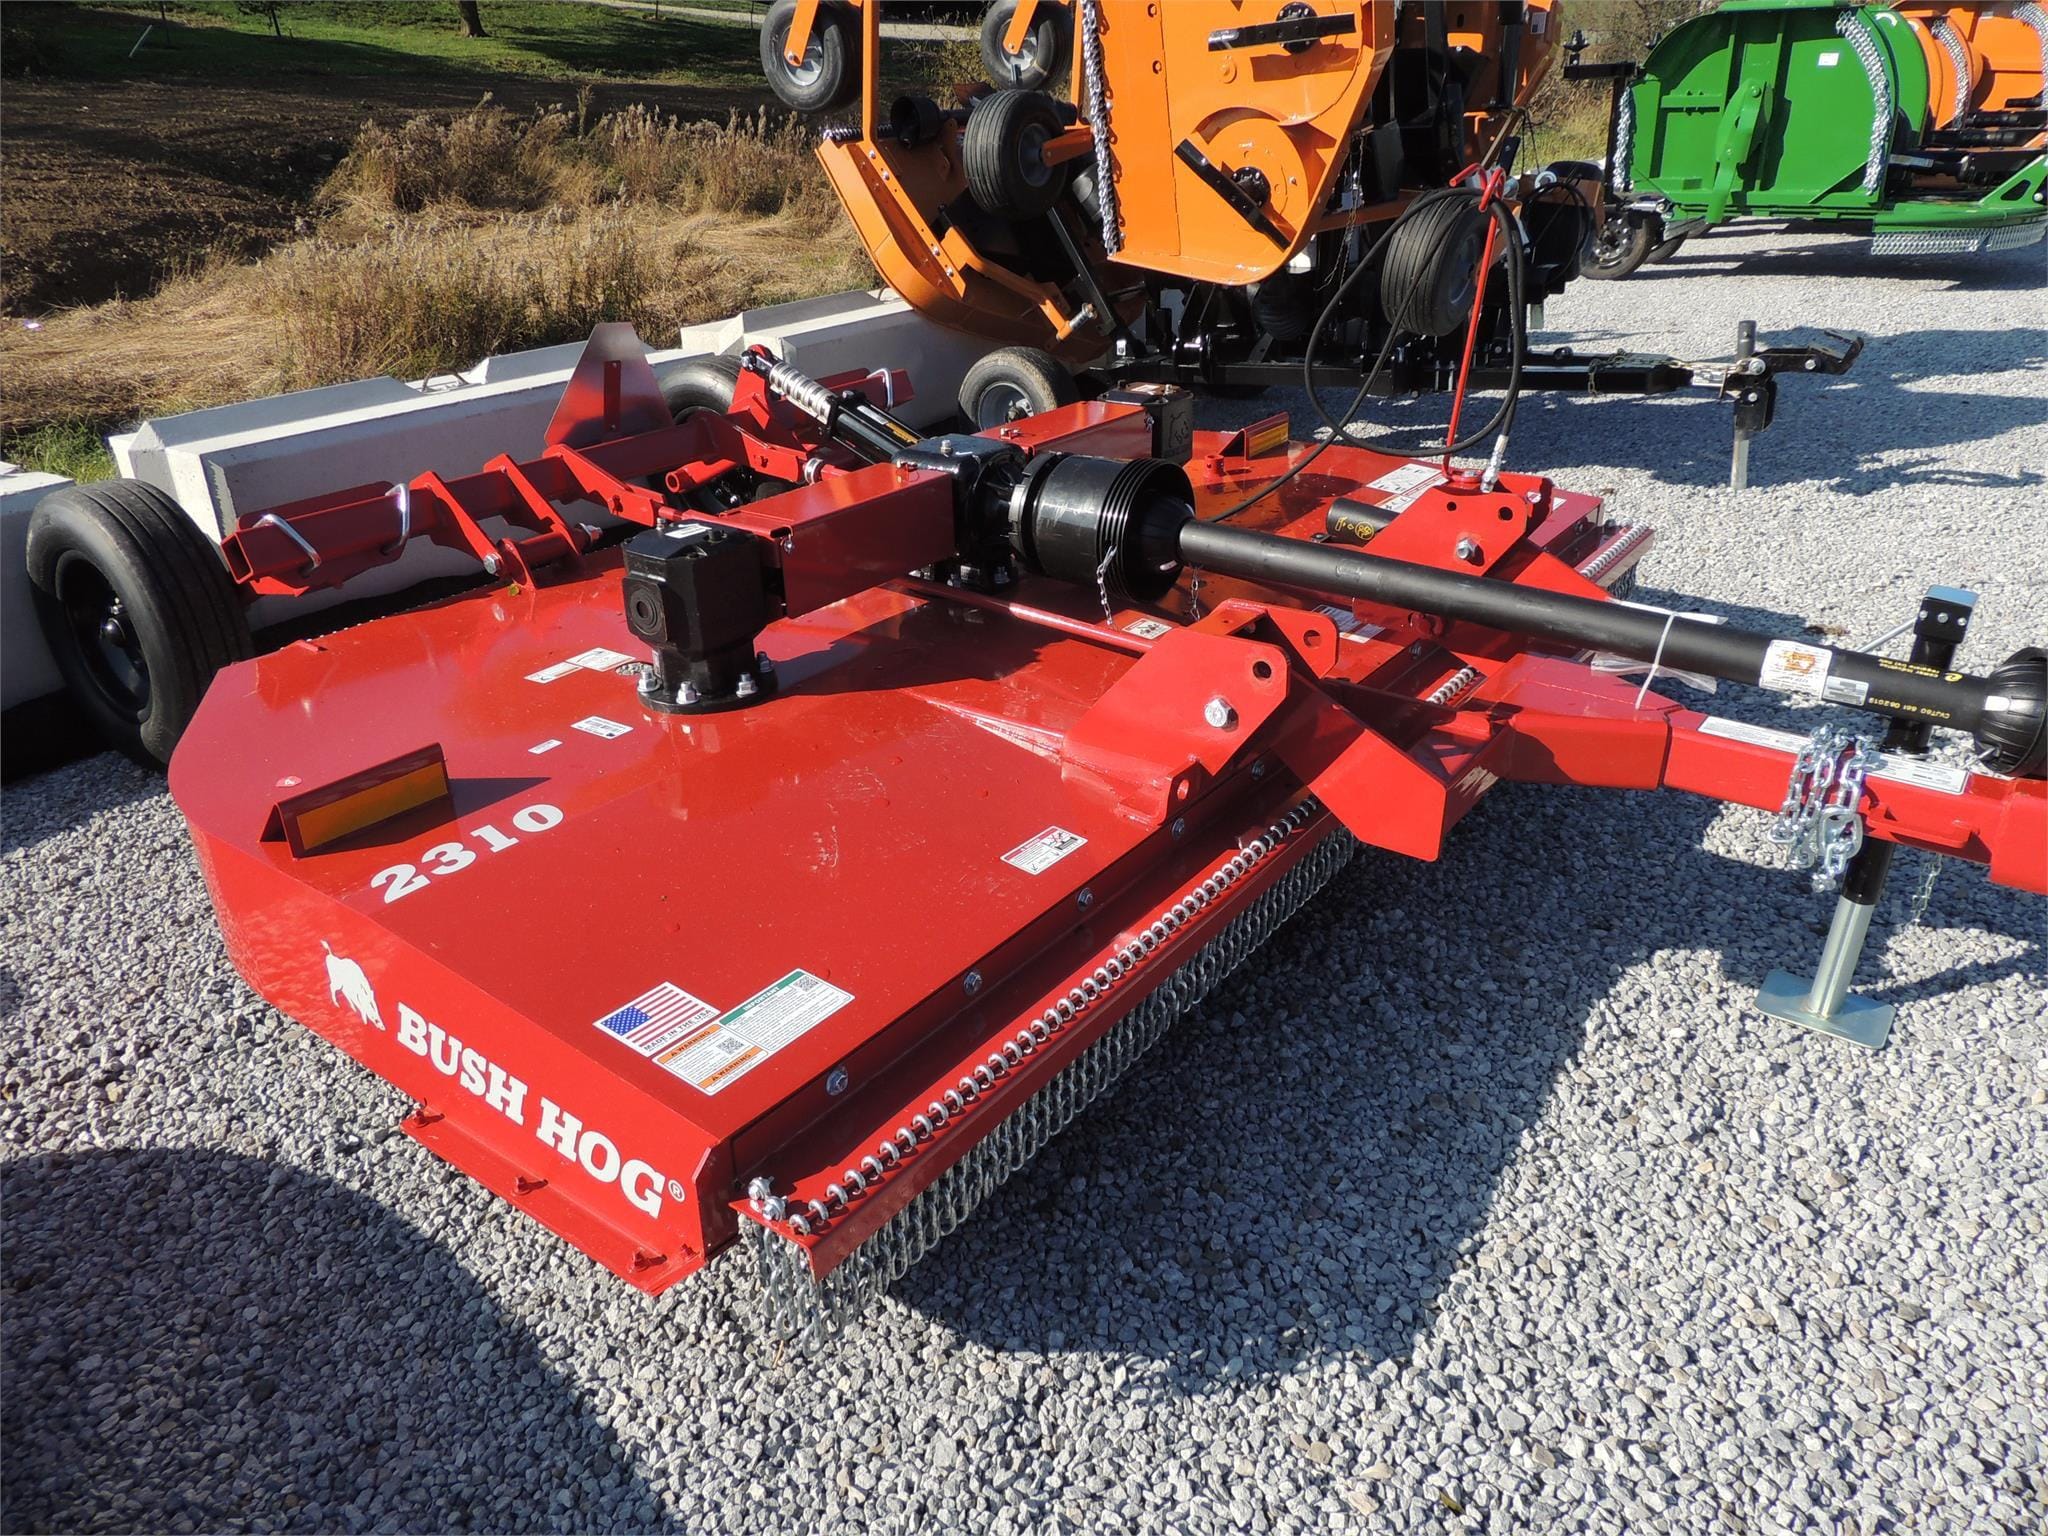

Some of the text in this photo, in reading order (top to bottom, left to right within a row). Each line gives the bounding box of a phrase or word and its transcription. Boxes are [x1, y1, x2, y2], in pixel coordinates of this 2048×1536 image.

[370, 804, 564, 904] 2310
[743, 986, 780, 1011] IMPORTANT
[643, 1009, 712, 1051] MADE IN THE USA
[678, 1030, 711, 1052] WARNING
[396, 1001, 529, 1125] BUSH
[718, 1053, 752, 1077] WARNING
